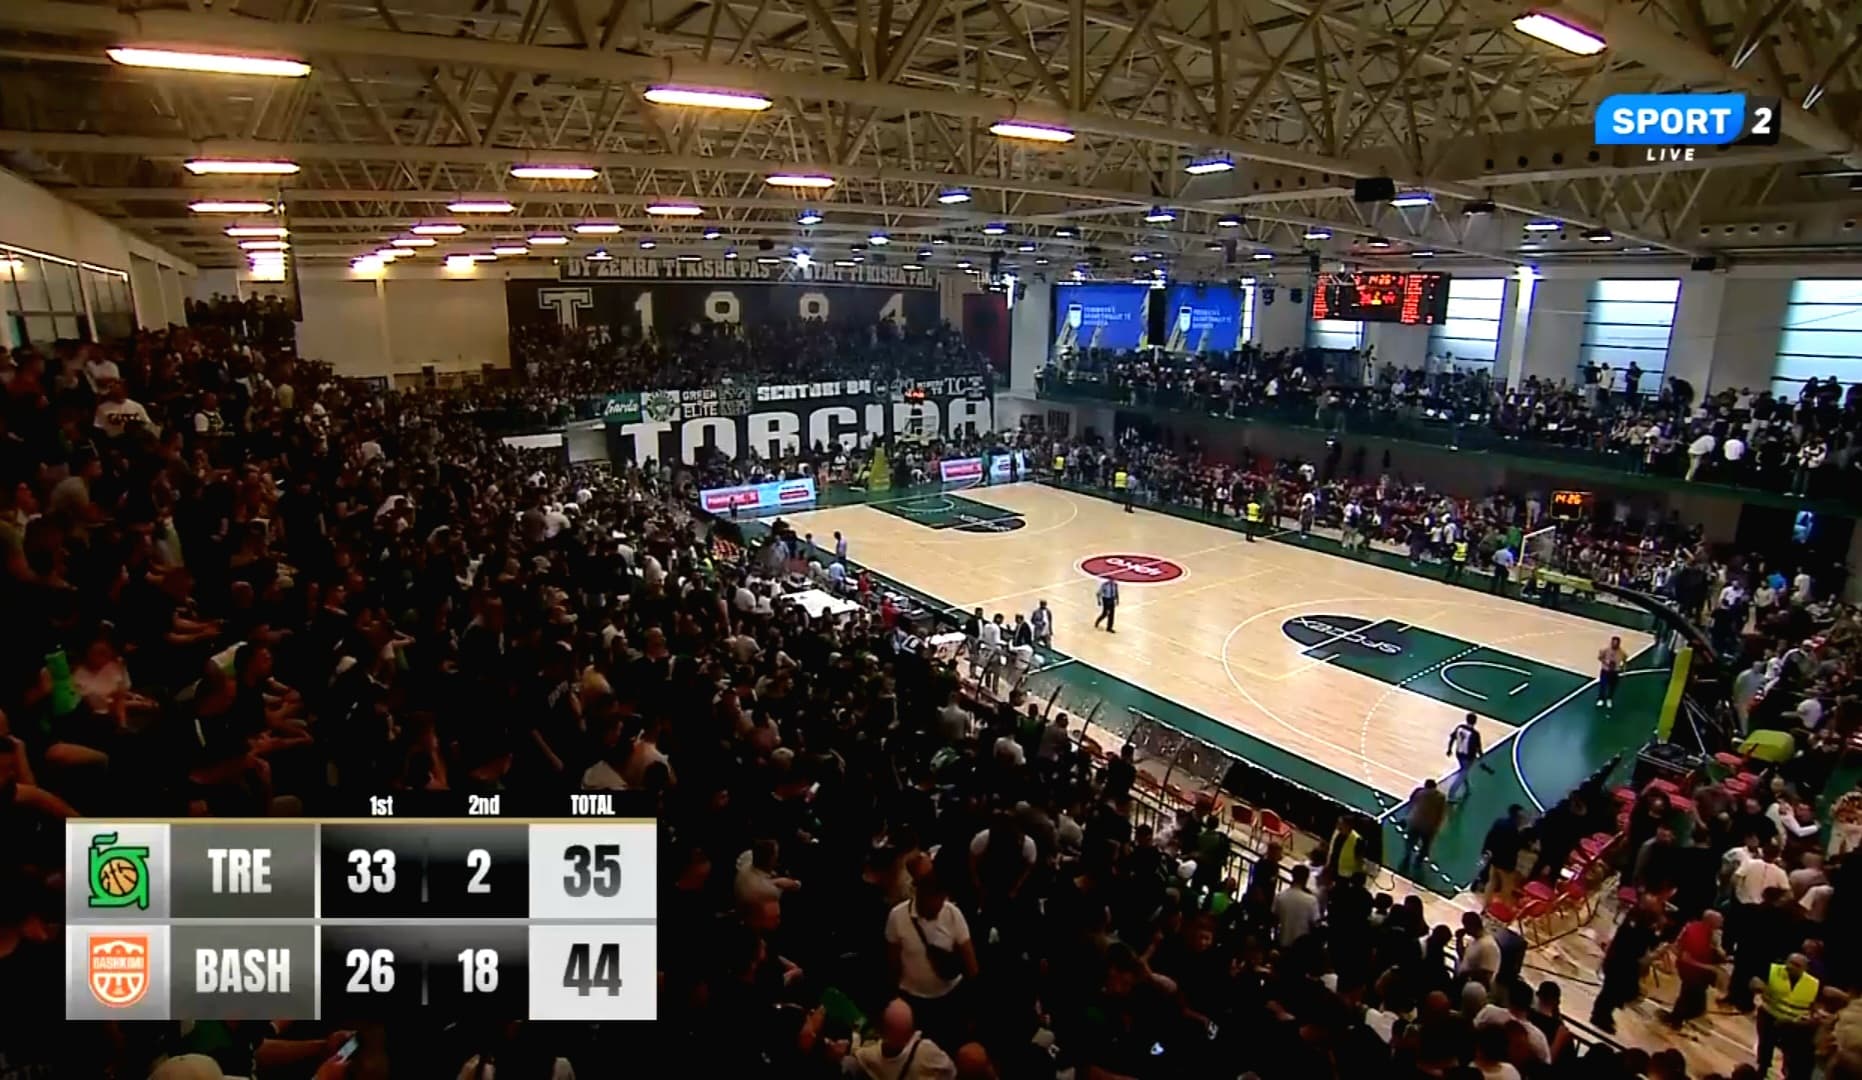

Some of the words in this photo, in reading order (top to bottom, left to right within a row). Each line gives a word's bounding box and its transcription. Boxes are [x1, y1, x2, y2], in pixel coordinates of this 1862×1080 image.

[686, 259, 737, 278] KISHA
[681, 400, 719, 418] ELITE
[620, 397, 992, 476] TORCIDA
